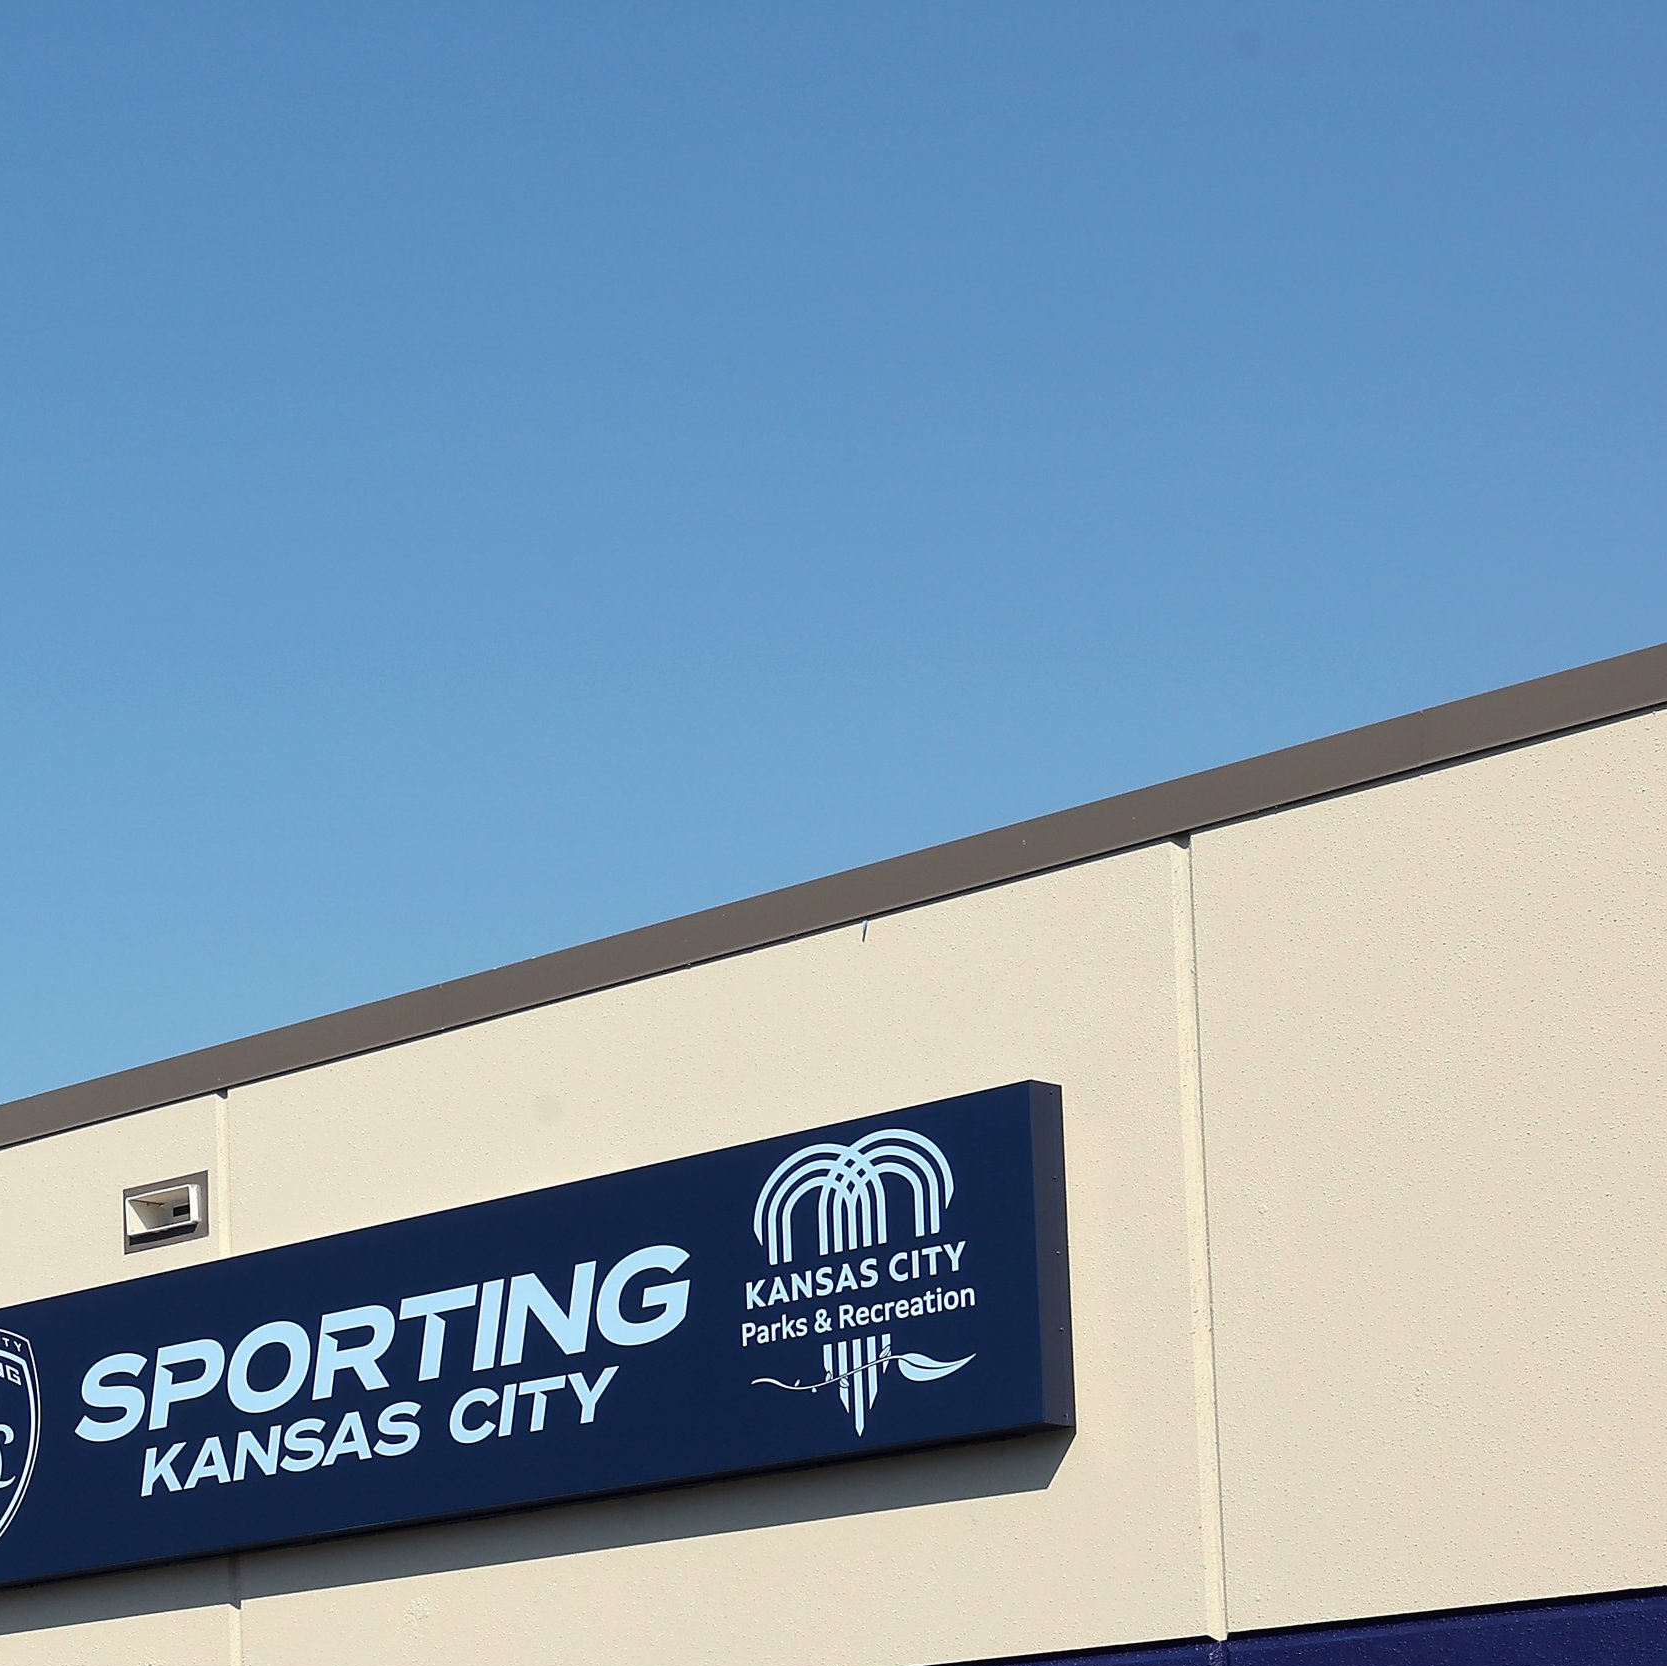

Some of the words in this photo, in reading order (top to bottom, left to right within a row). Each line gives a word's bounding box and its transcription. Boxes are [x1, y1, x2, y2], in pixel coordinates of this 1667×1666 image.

[741, 1313, 808, 1347] Parks
[814, 1308, 833, 1334] &
[838, 1286, 976, 1329] Recreation
[745, 1258, 879, 1310] KANSAS
[888, 1240, 967, 1282] CITY
[73, 1244, 692, 1443] SPORTING
[139, 1401, 423, 1498] KANSAS
[449, 1365, 620, 1444] CITY
